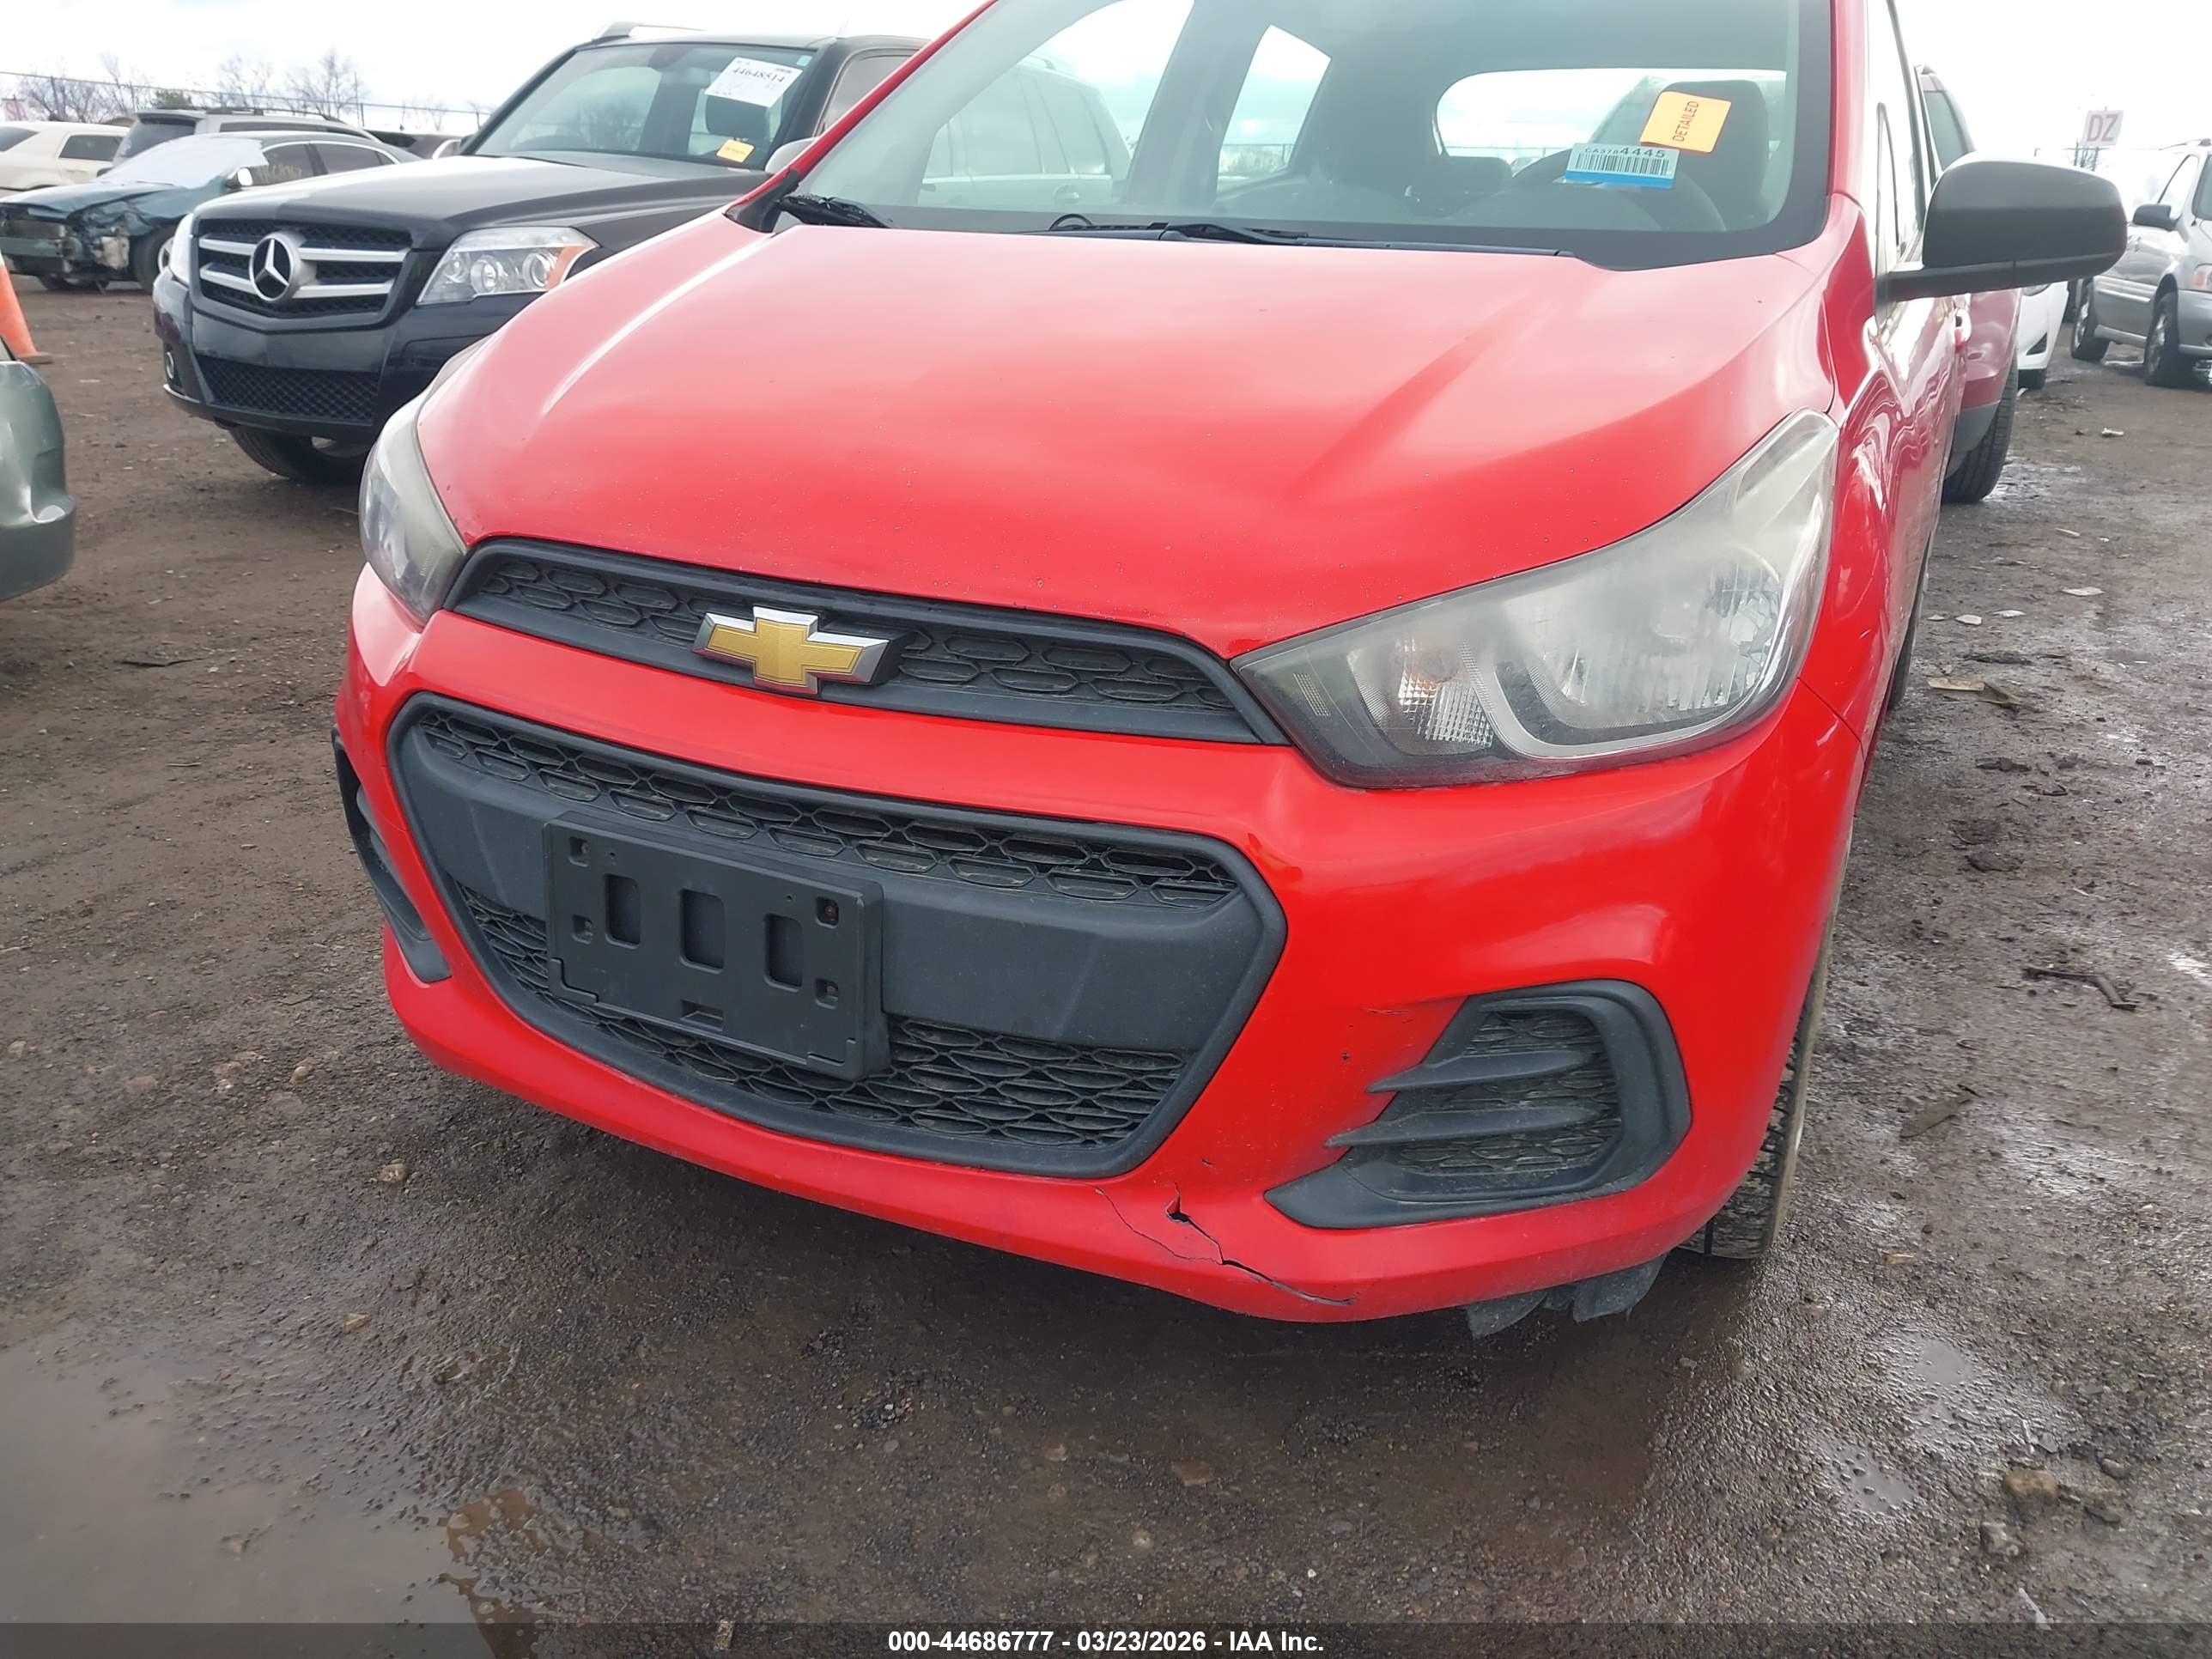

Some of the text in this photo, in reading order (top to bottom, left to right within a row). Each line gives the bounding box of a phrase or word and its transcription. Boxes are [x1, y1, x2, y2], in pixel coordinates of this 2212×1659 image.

[732, 67, 785, 82] 44648514
[1672, 100, 1699, 143] DETAILED
[2087, 113, 2118, 142] DZ
